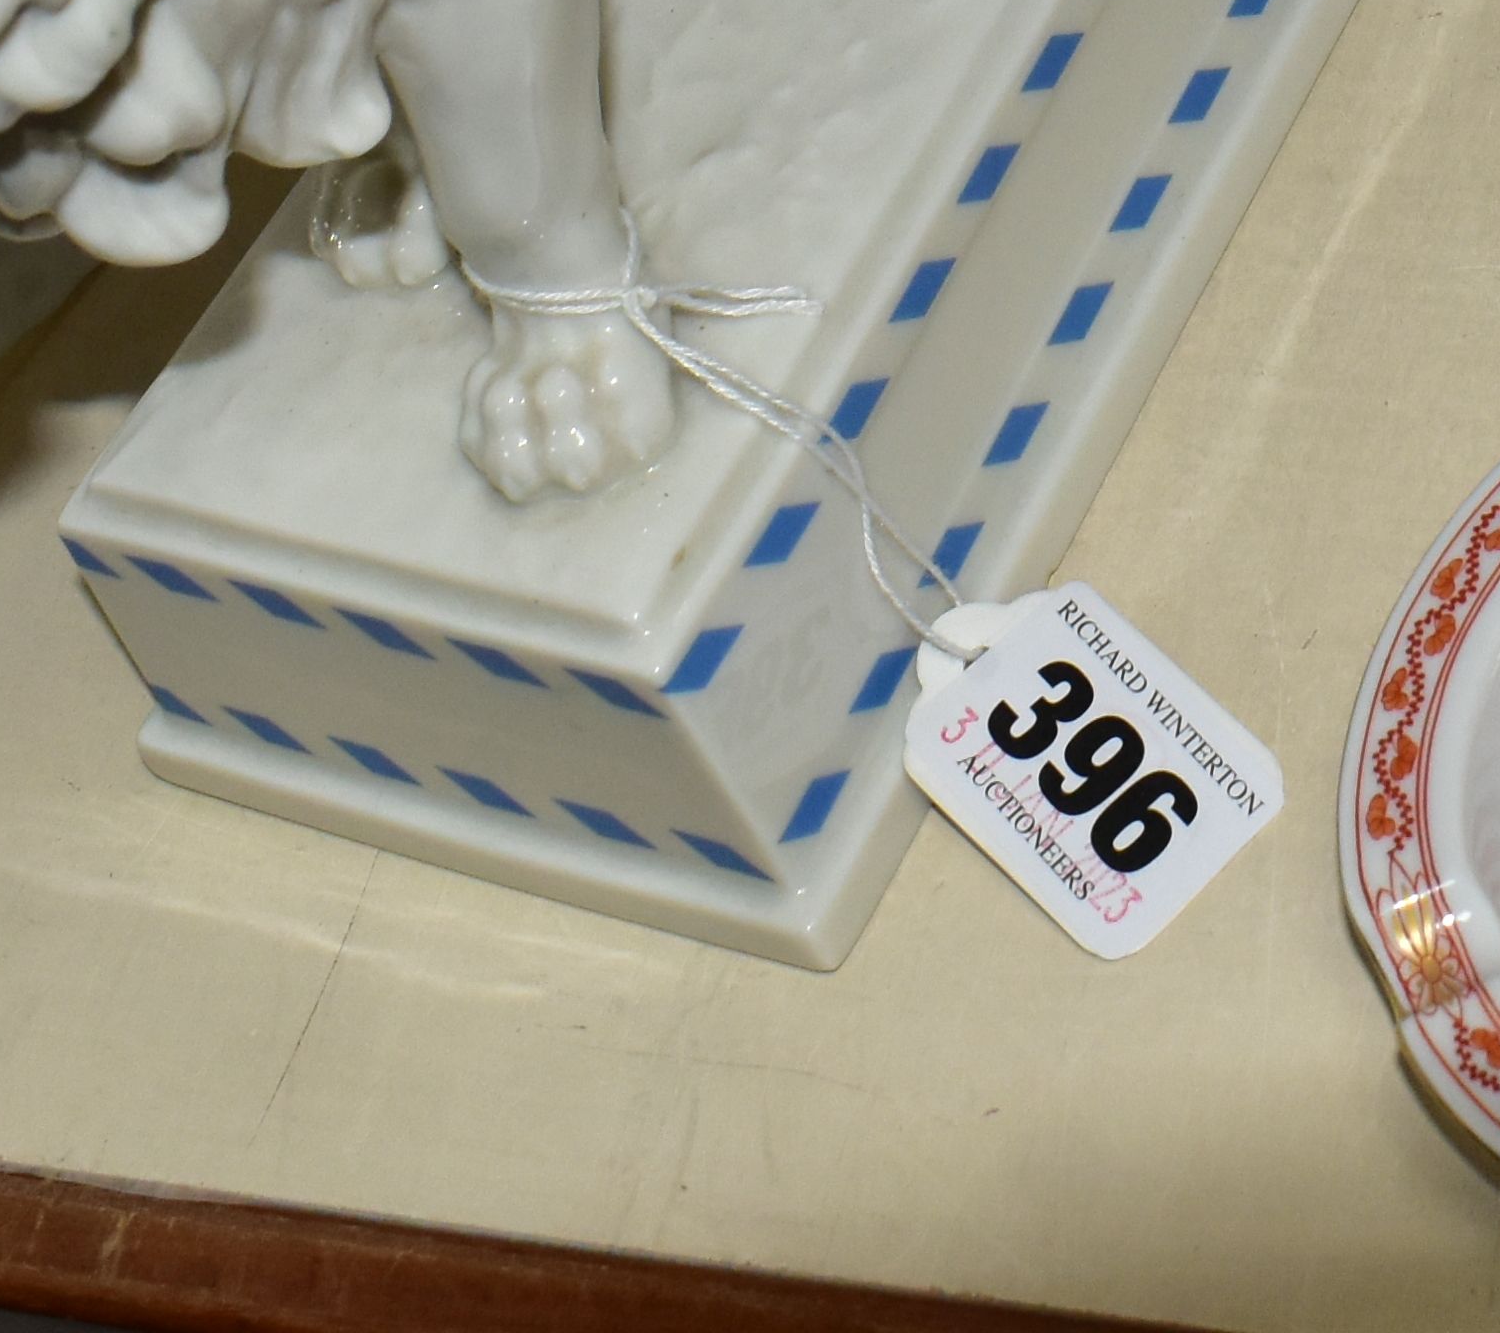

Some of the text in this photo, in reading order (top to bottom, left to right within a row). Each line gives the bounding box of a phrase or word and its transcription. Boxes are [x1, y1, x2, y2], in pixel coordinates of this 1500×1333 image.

[987, 660, 1198, 873] 396
[1057, 599, 1265, 817] RICHARD WINTERTON
[957, 754, 1095, 901] AUCTIONEERS
